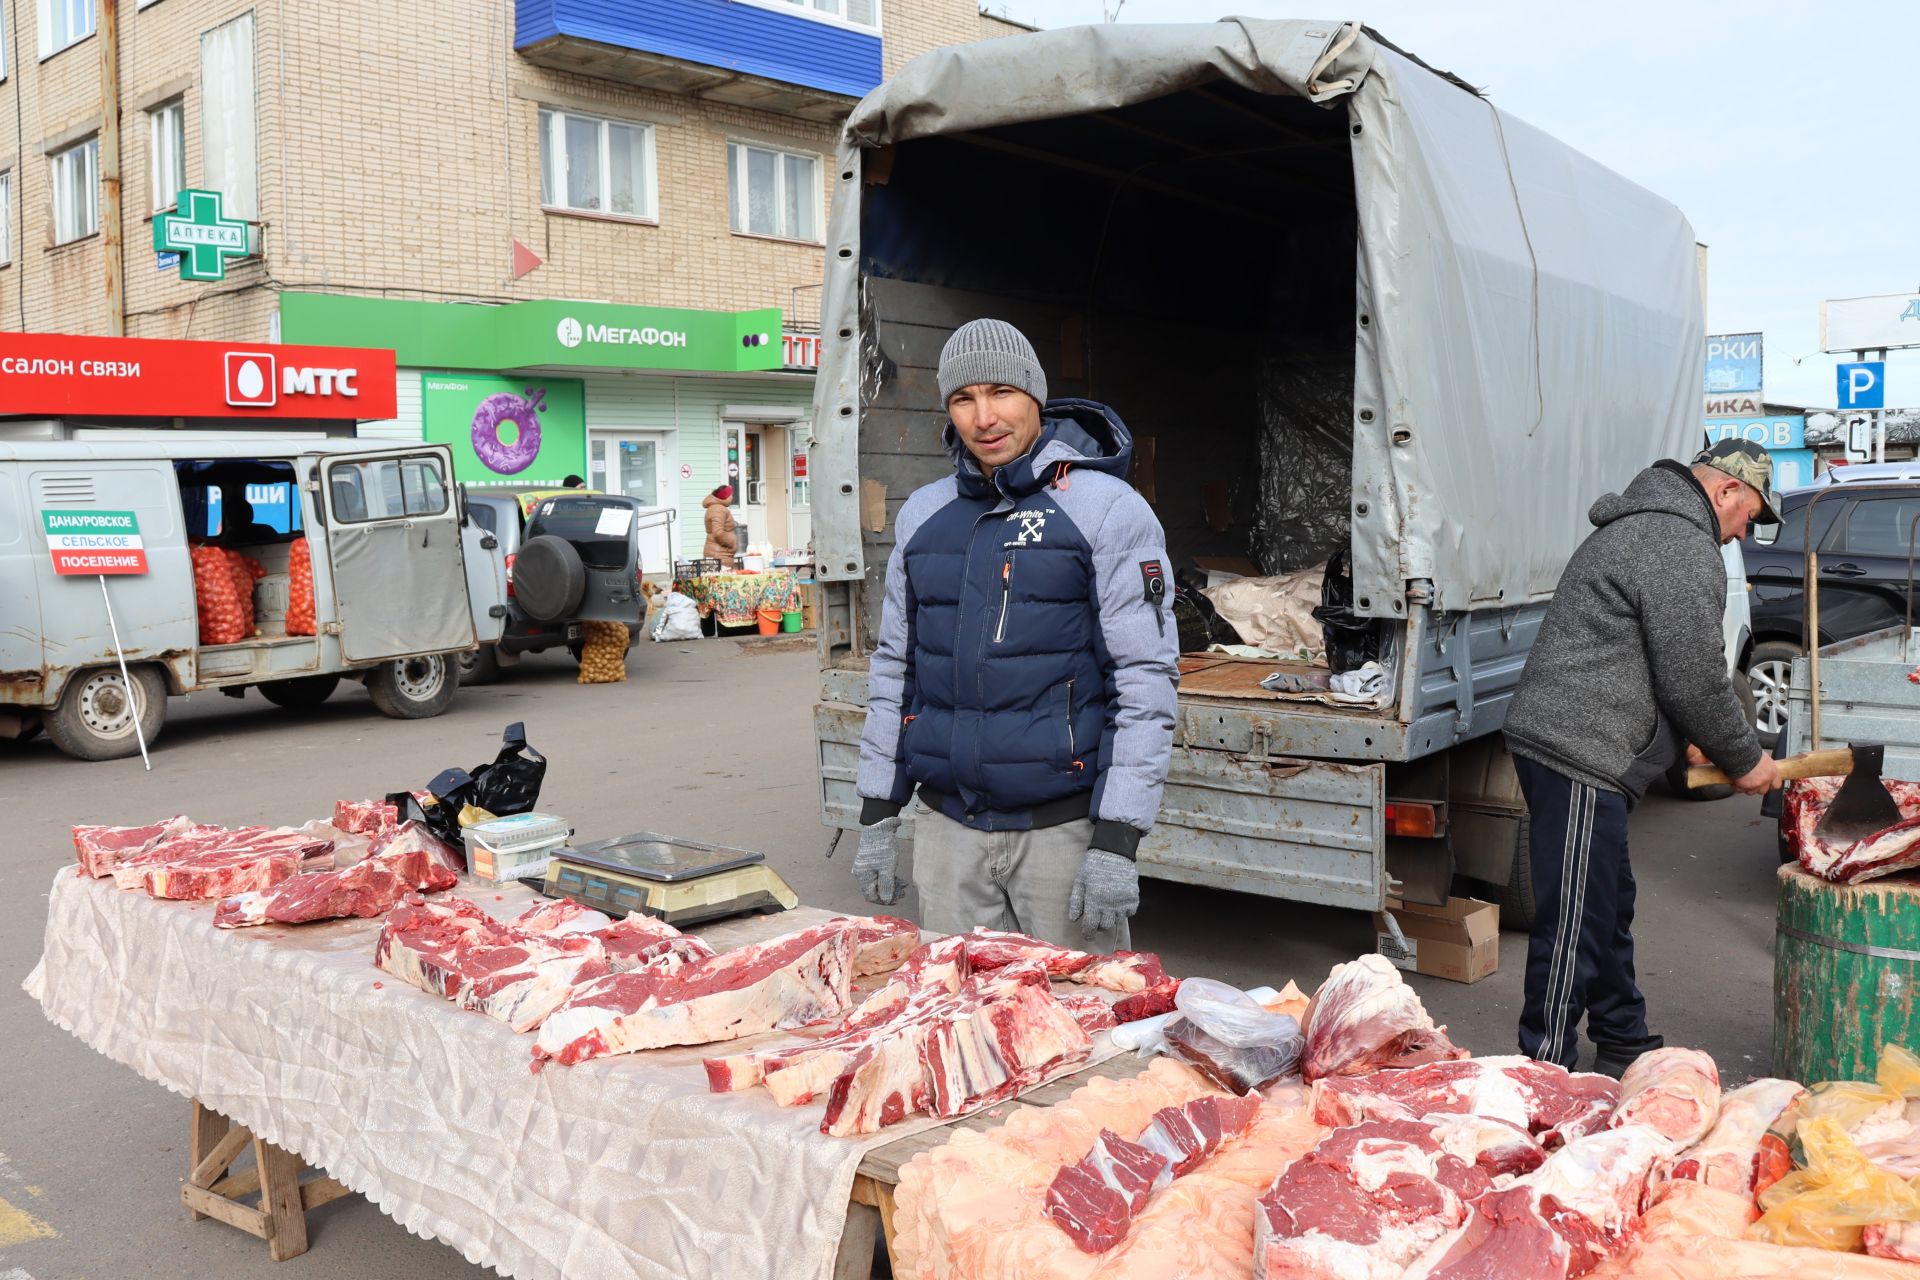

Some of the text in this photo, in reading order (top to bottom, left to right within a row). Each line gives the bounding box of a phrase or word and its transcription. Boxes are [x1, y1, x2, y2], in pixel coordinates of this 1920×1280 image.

[173, 226, 237, 241] АПТЕКА
[1, 357, 140, 377] салон связи
[282, 366, 358, 396] МТС
[1848, 368, 1875, 404] P
[48, 515, 133, 528] ДАНАУРОВСКОЕ
[61, 536, 129, 547] СЕЛЬСКОЕ
[60, 556, 139, 568] ПОСЕЛЕНИЕ
